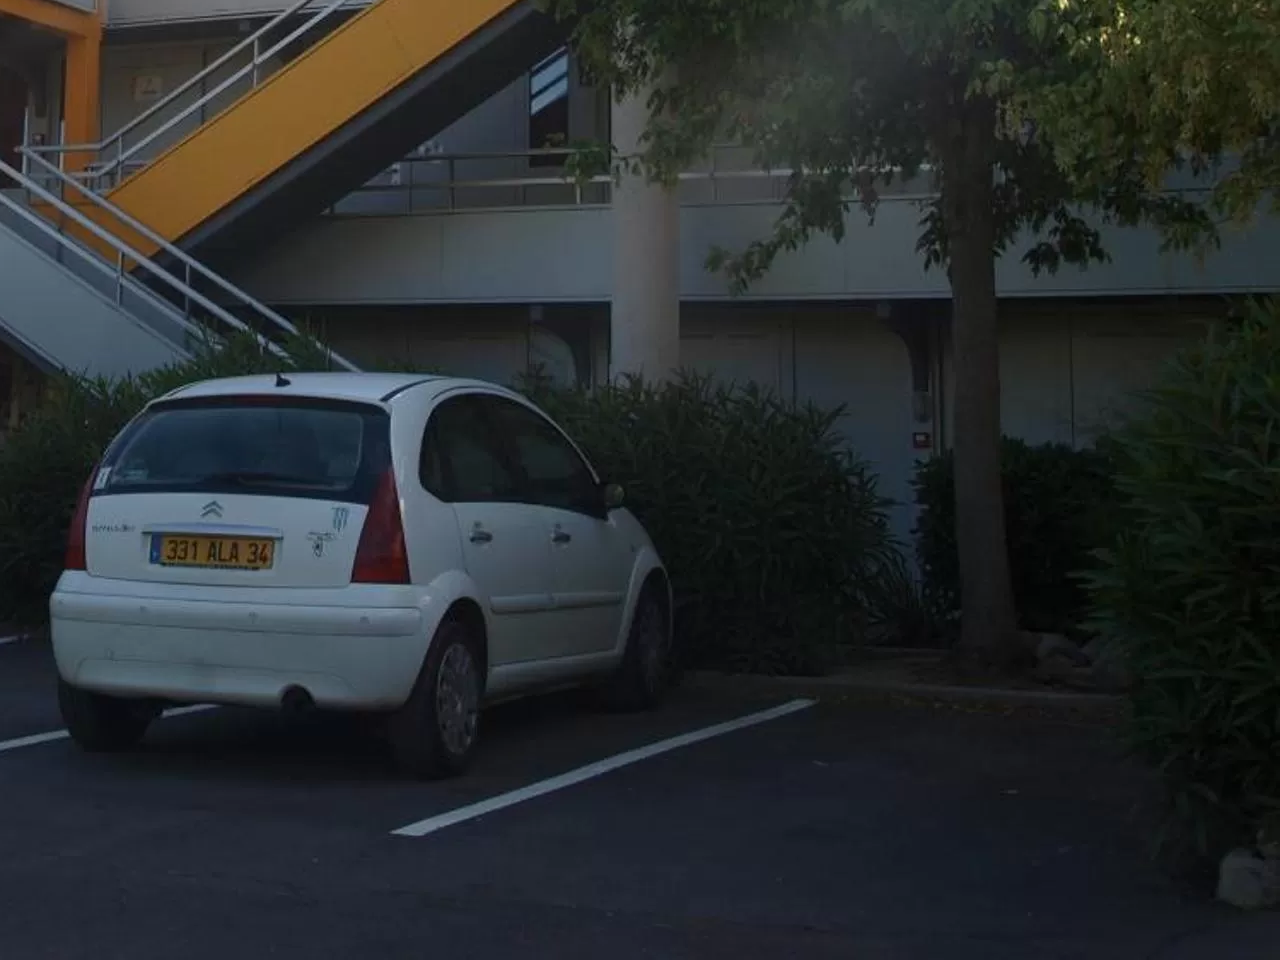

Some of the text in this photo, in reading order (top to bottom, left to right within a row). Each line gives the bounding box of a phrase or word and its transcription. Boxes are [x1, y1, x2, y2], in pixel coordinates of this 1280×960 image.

[165, 538, 269, 565] 331 ALA 34
